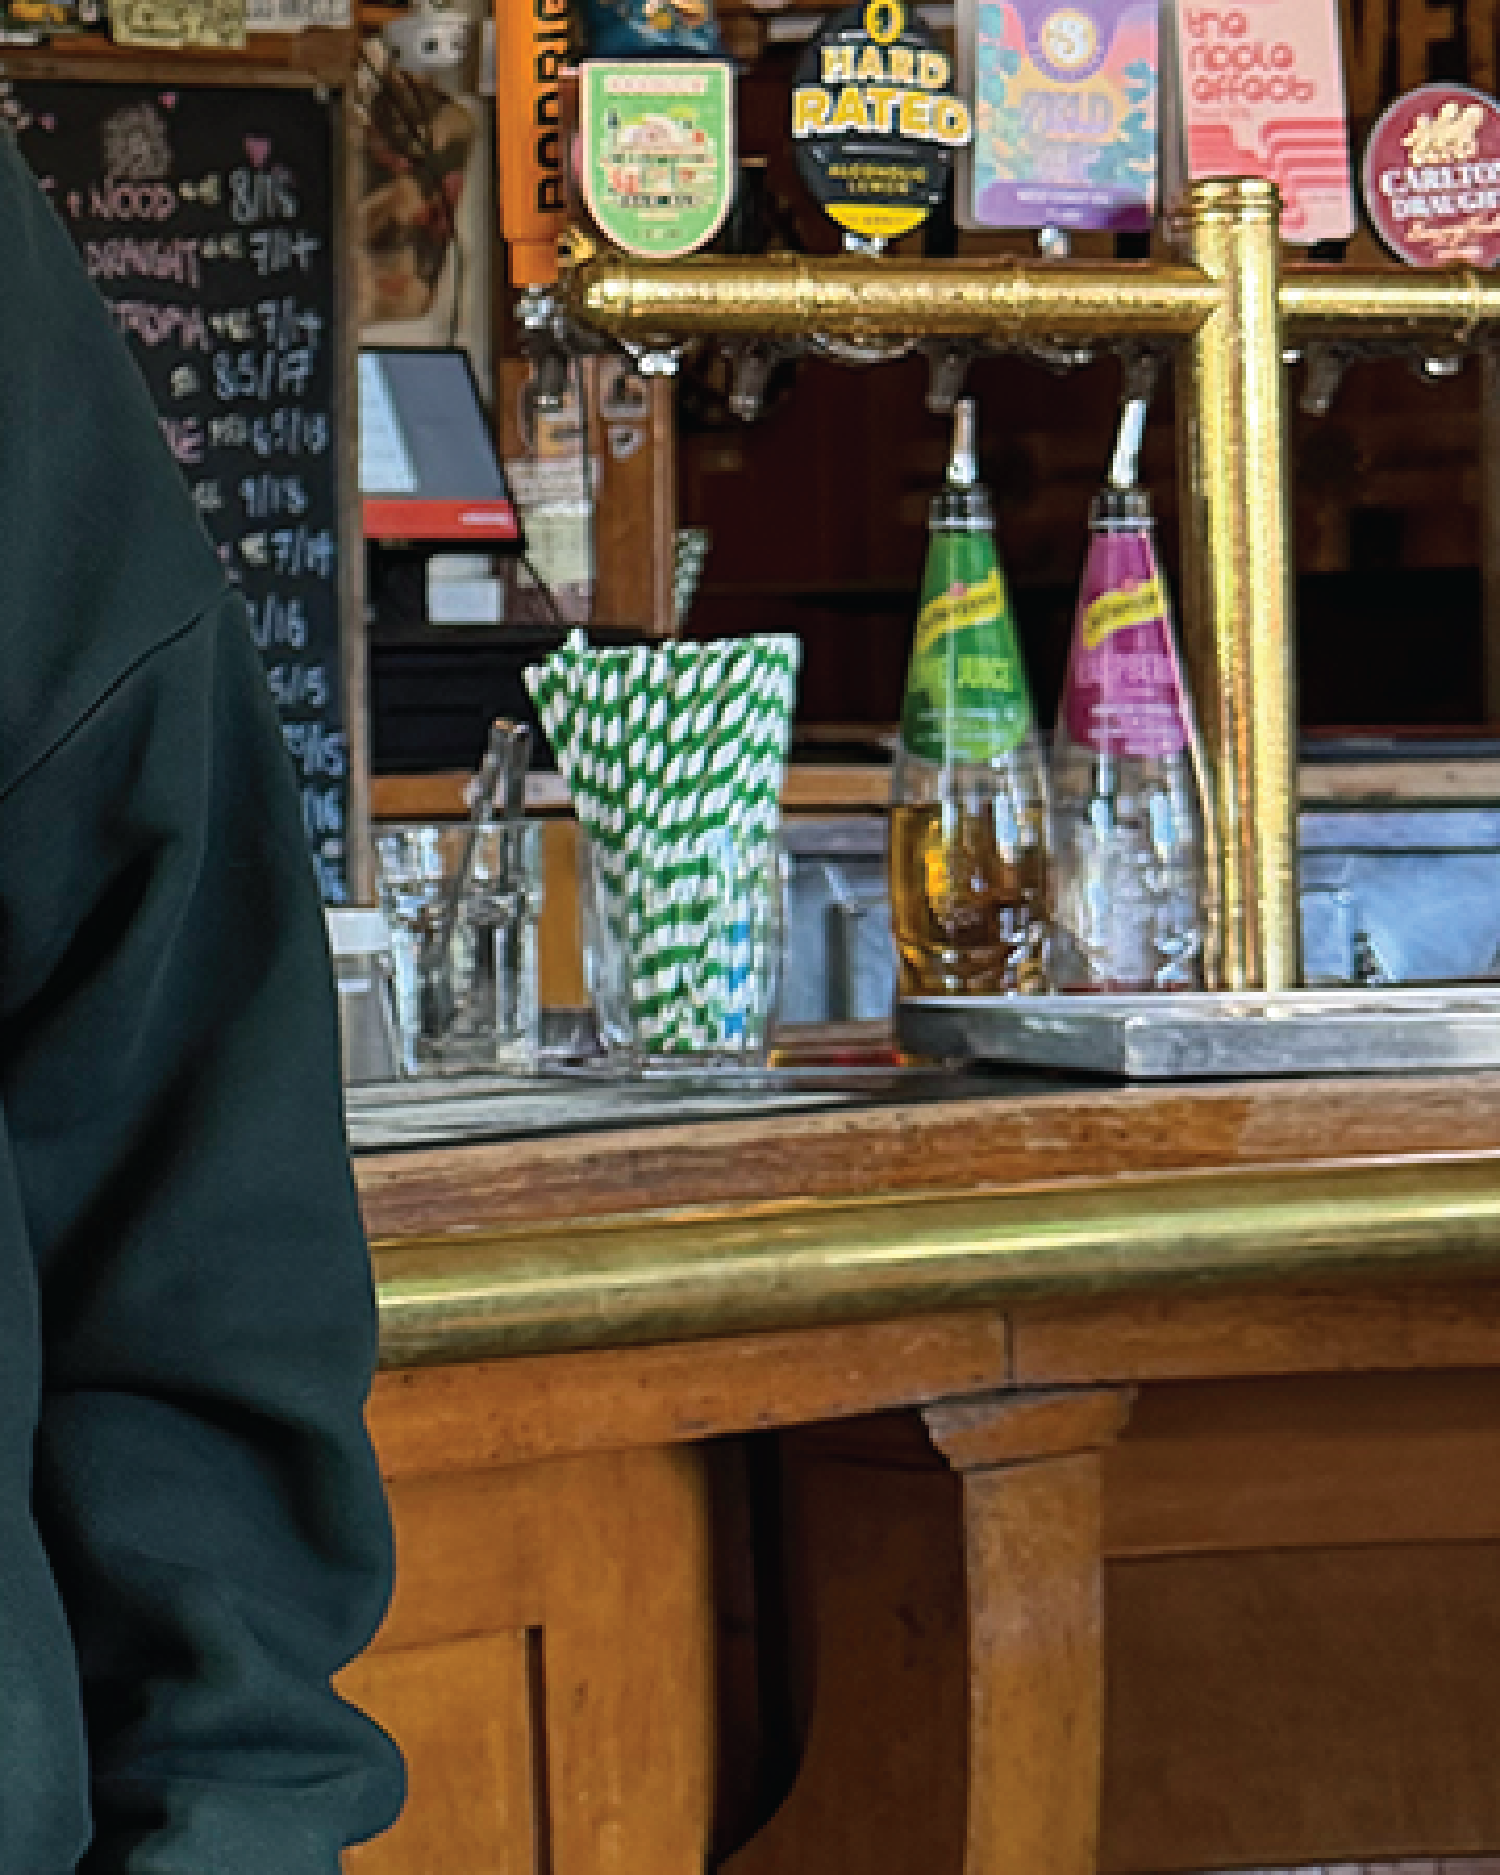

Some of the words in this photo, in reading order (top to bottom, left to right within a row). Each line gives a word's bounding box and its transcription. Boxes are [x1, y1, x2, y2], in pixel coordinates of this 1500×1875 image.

[1186, 9, 1248, 38] the
[819, 44, 951, 89] HARD
[791, 85, 973, 149] RATED
[1390, 190, 1500, 220] DRAUGH
